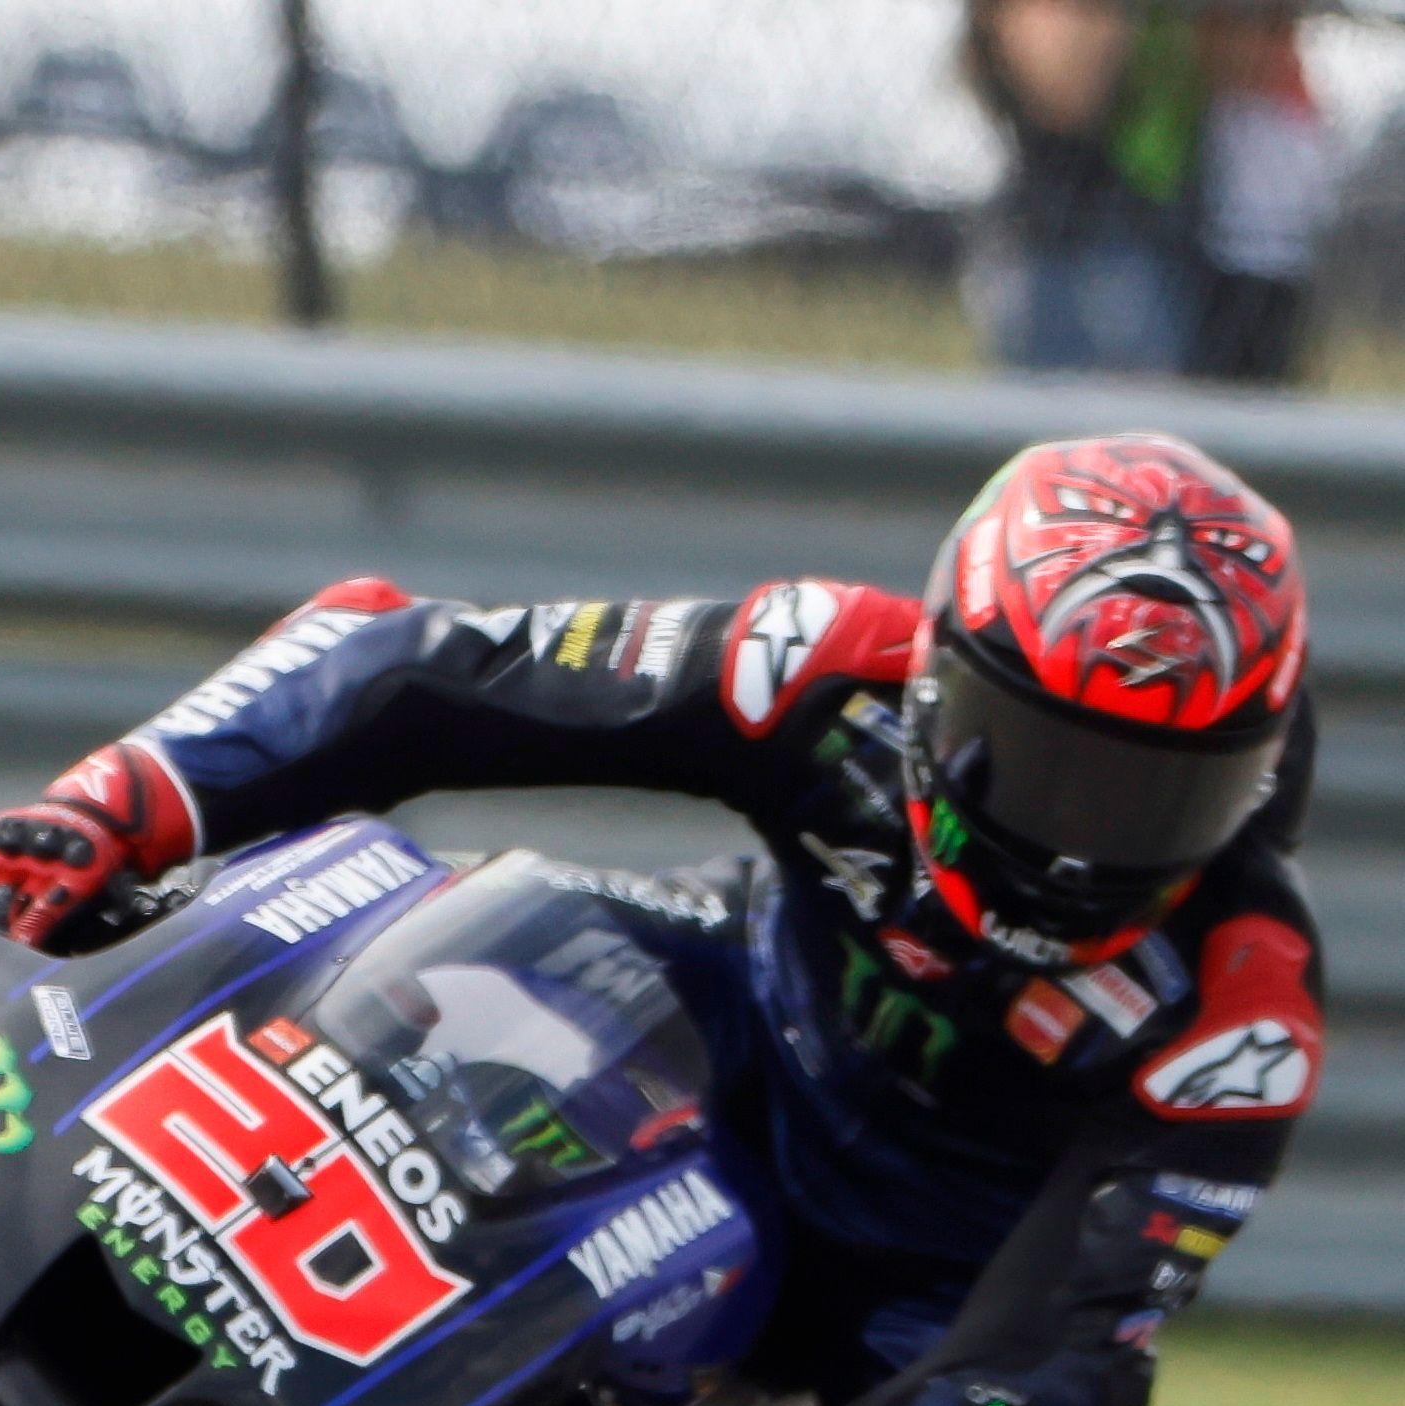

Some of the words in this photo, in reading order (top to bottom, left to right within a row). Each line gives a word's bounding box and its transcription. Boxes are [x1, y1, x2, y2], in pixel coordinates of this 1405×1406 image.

[240, 840, 428, 944] YAMAHA
[287, 1044, 466, 1244] ENEOS
[72, 1147, 297, 1395] MONSTER
[75, 1203, 245, 1369] ENERGY
[567, 1168, 732, 1299] YAMAHA
